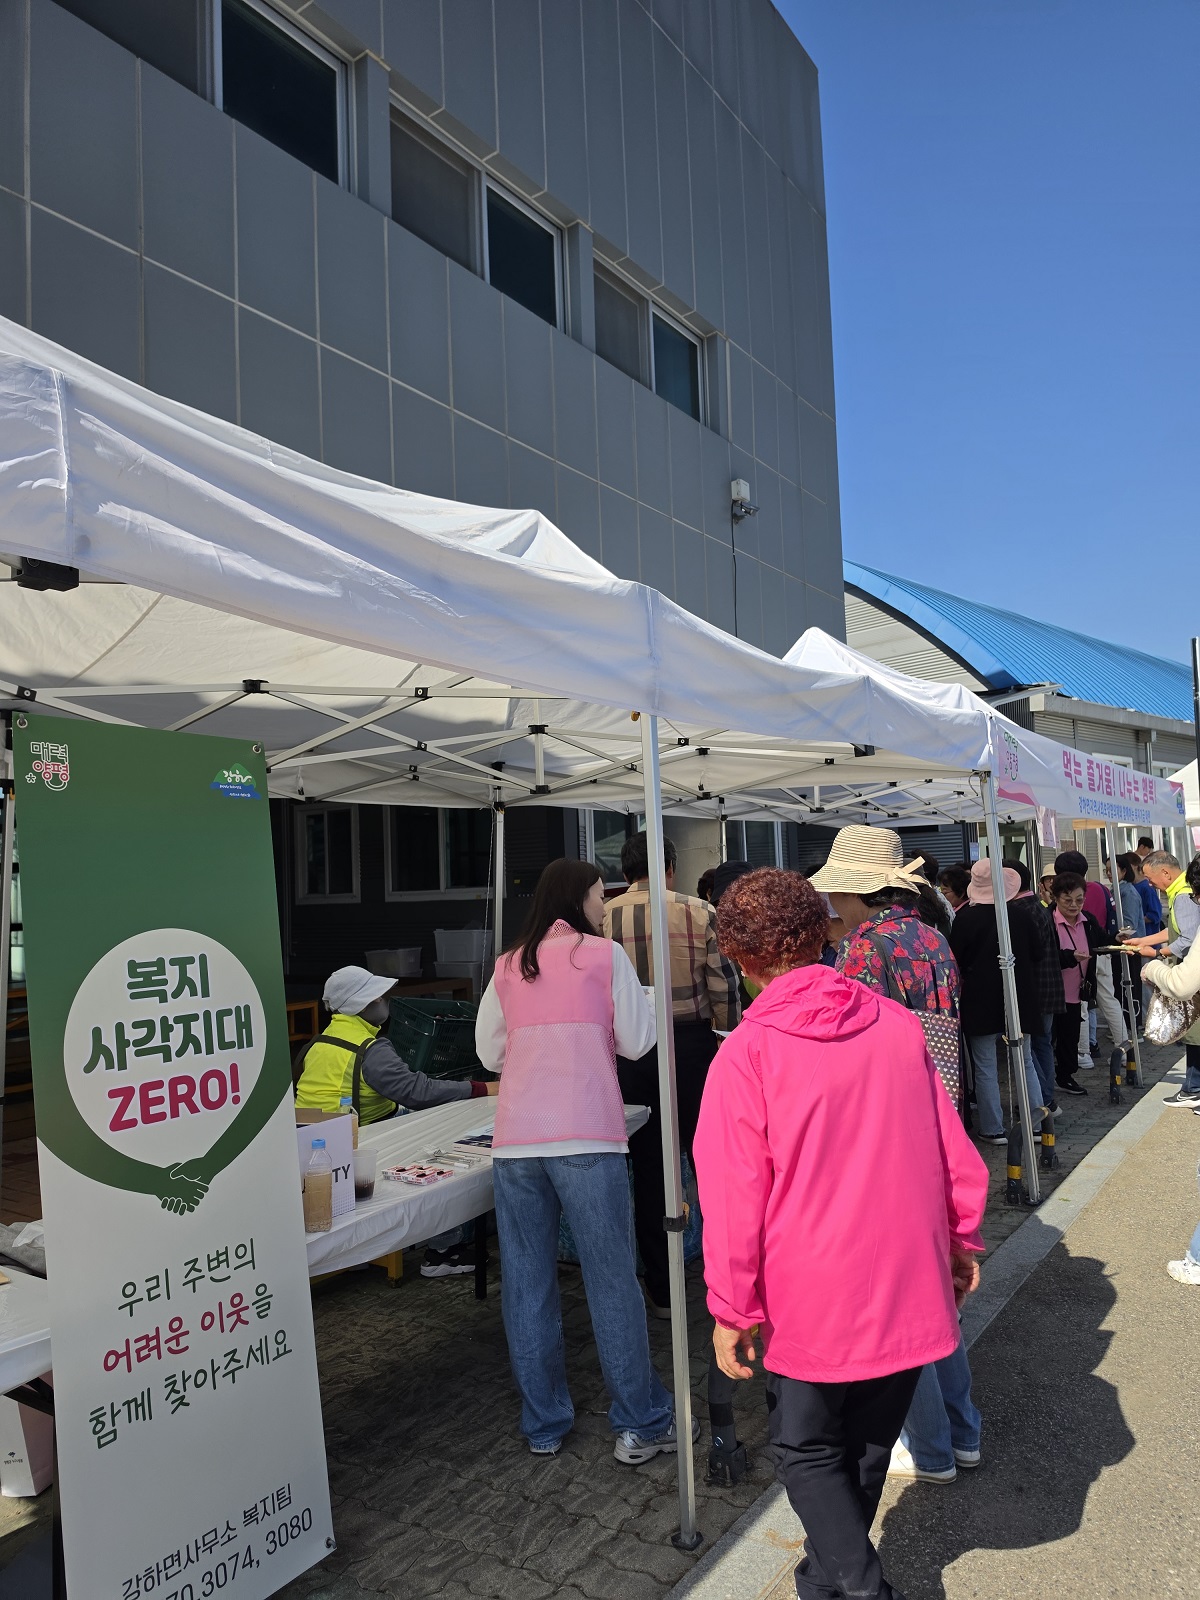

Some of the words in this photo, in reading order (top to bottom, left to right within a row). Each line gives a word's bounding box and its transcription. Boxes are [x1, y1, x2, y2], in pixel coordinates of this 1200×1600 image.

[30, 741, 69, 762] 매력
[32, 760, 70, 788] 양평
[1062, 750, 1083, 789] 먹는
[1087, 759, 1116, 797] 즐거움!
[1119, 769, 1140, 802] 나누는
[1142, 777, 1157, 805] 행복!
[126, 953, 210, 1003] 복지
[83, 1004, 254, 1074] 사각지대
[107, 1062, 241, 1132] ZERO!
[118, 1269, 171, 1317] 우리
[182, 1238, 256, 1293] 주변의
[103, 1317, 190, 1373] 어려운
[200, 1283, 273, 1334] 이웃을
[89, 1387, 153, 1449] 함께
[164, 1329, 293, 1414] 찾아주세요
[122, 1520, 238, 1600] 강하면사무소
[243, 1483, 292, 1526] 복지팀
[265, 1507, 312, 1556] 3080
